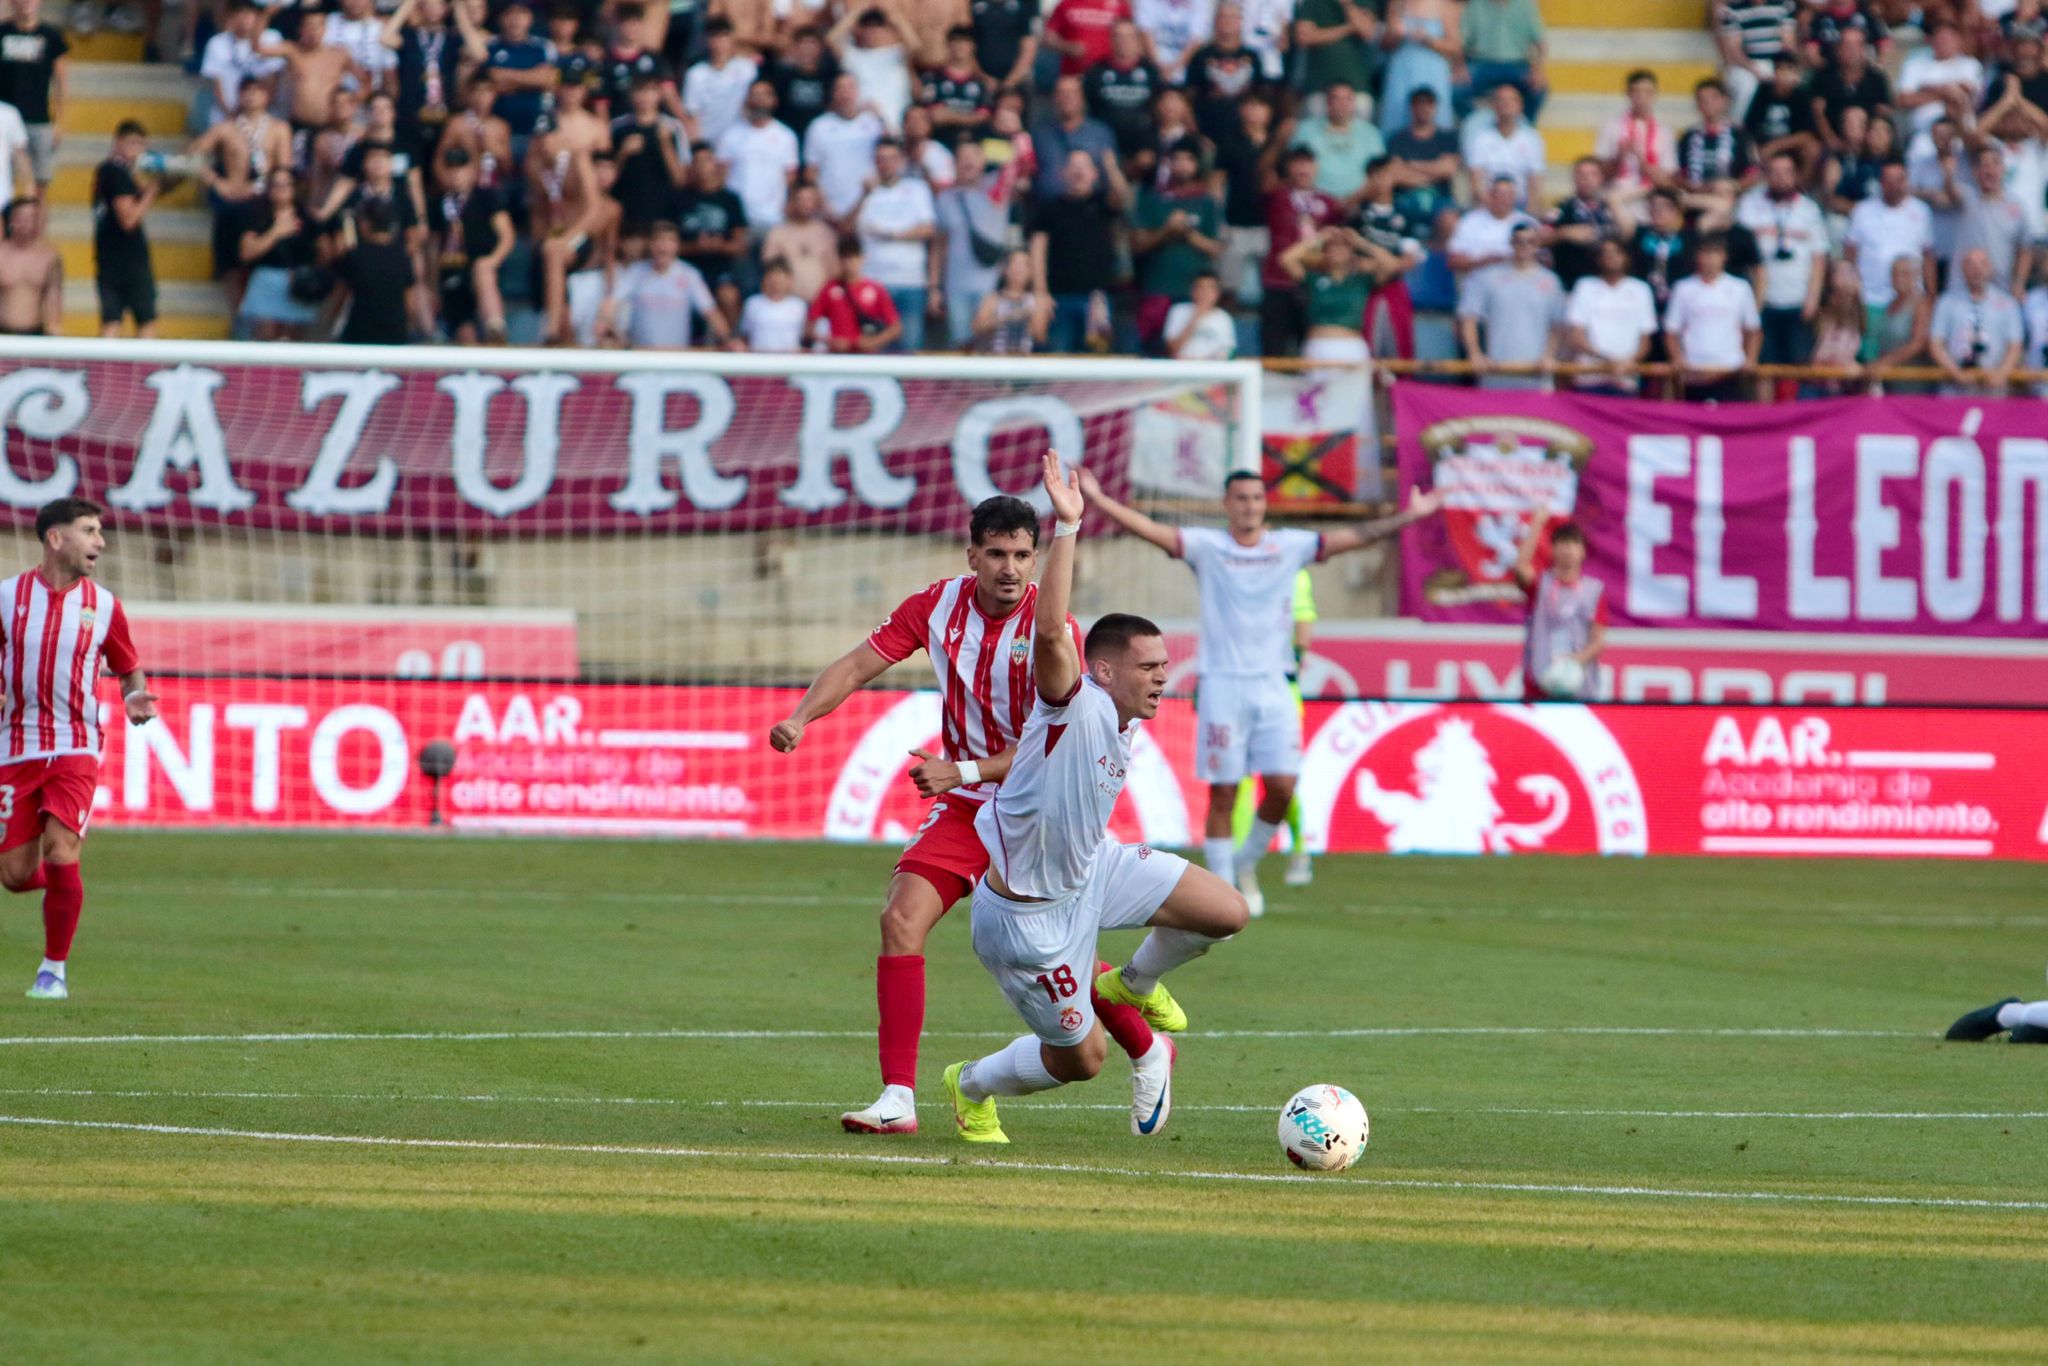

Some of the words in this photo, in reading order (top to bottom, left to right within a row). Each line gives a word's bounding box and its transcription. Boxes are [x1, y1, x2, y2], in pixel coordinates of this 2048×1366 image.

[0, 364, 1085, 518] CAZURRO
[1627, 434, 1758, 620] EL
[1788, 407, 2048, 622] LEÓN
[95, 703, 409, 814] NTO
[1702, 714, 1844, 767] AAR.
[452, 781, 523, 810] alto
[1701, 800, 1773, 830] alto
[1036, 963, 1078, 1004] 18
